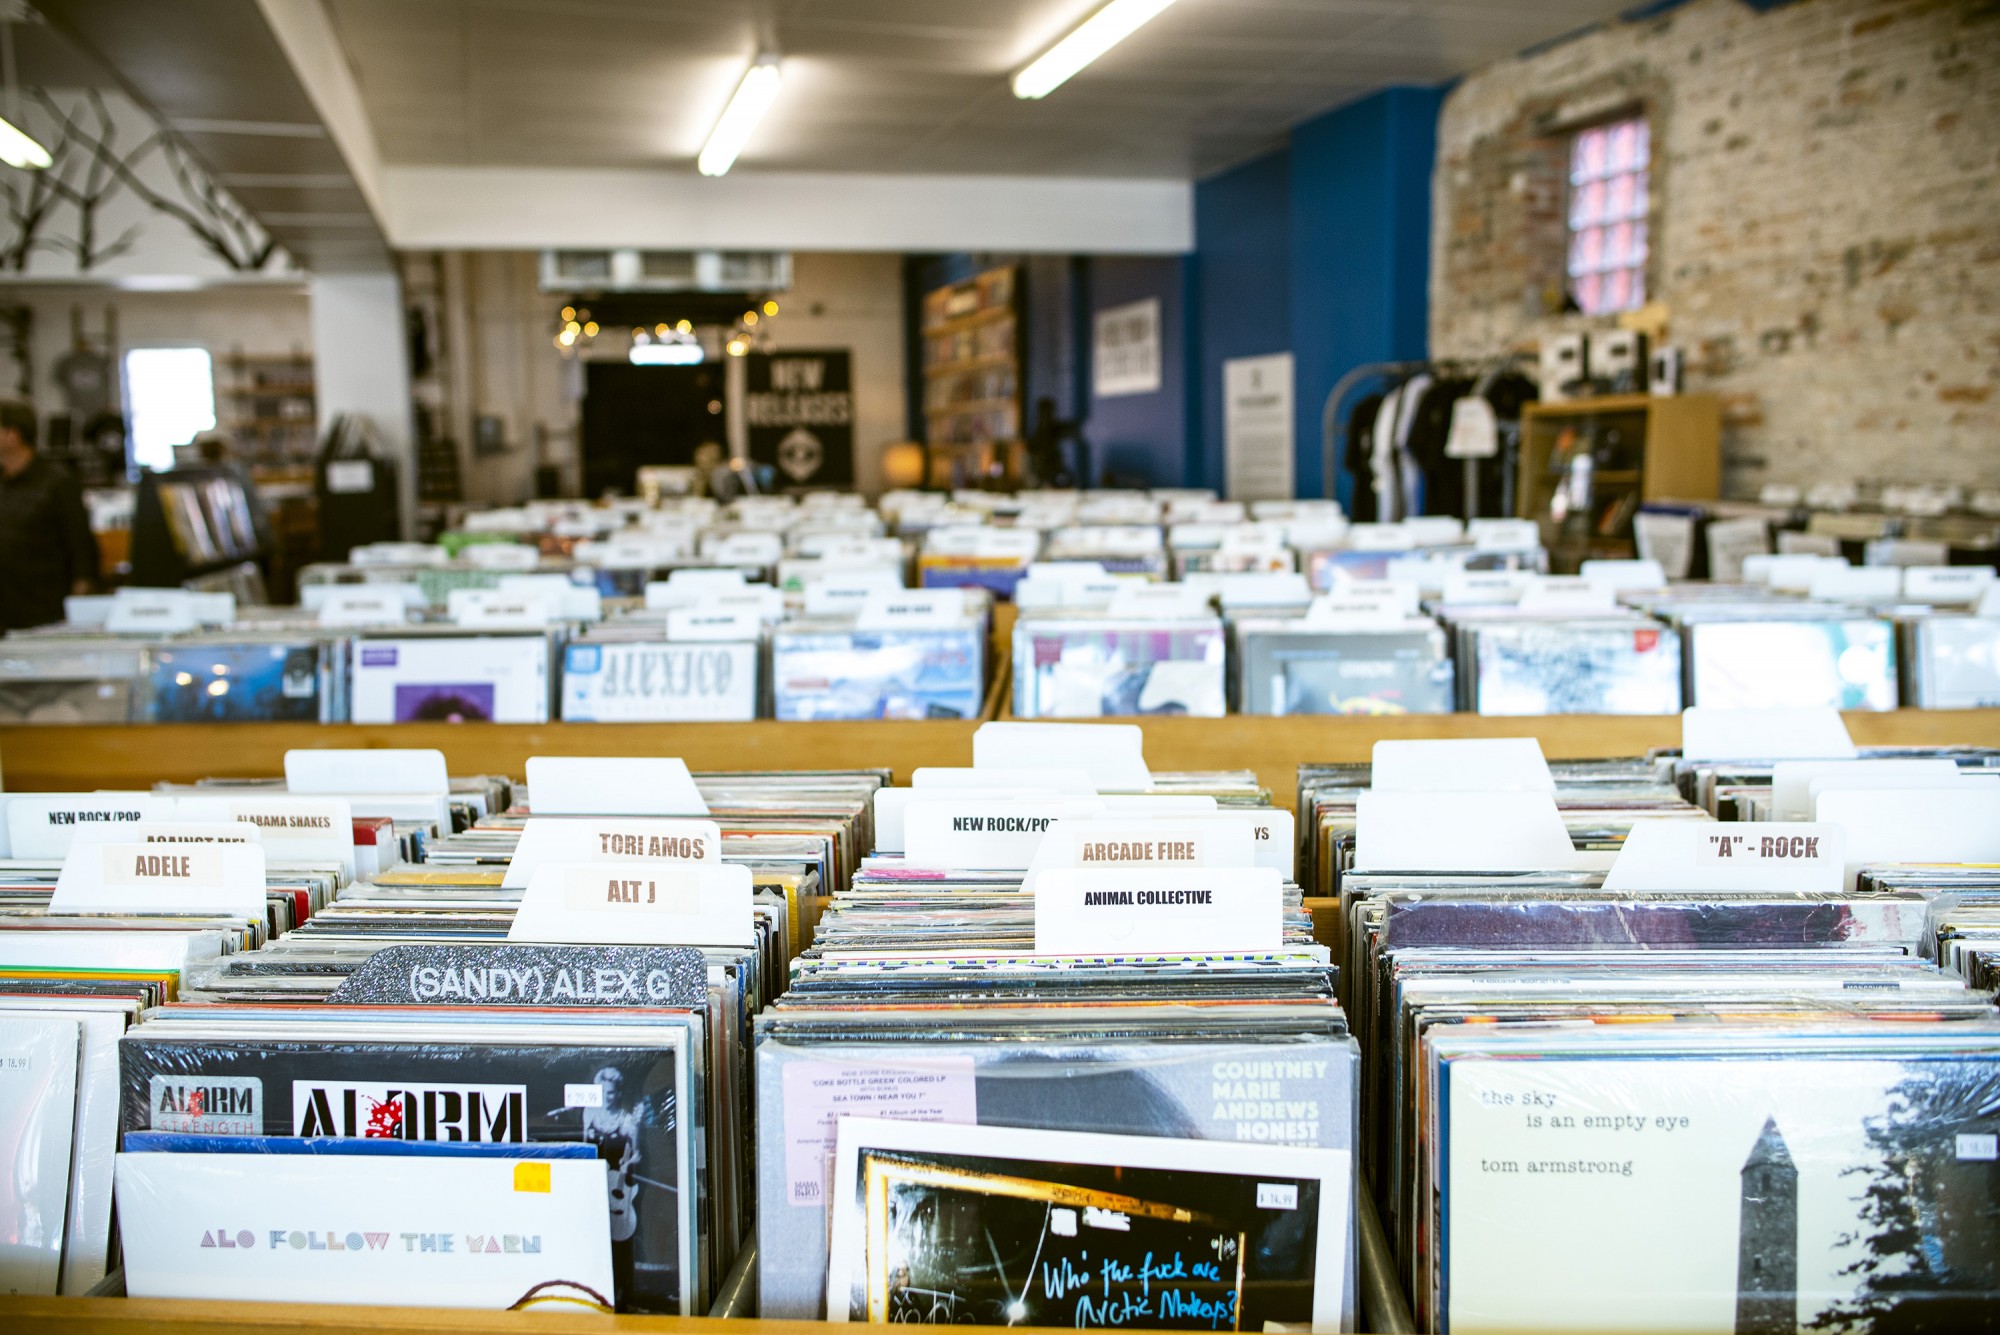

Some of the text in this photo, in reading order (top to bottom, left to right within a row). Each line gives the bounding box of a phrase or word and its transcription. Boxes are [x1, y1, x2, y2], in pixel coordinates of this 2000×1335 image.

[48, 811, 141, 825] NEW ROCK/POP
[237, 814, 331, 828] ALABAMA SHAKES
[953, 817, 1058, 832] NEW ROCK/PO
[599, 833, 705, 860] TORI AMOS
[1083, 842, 1195, 861] ARCADE FIRE
[1709, 836, 1743, 857] "A"
[1760, 836, 1820, 858] ROCK
[135, 855, 191, 878] ADELE
[607, 879, 656, 904] ALT J
[1084, 890, 1212, 906] ANIMAL COLLECTIVE
[410, 964, 671, 1004] (SANDY) ALEX G
[8, 1058, 27, 1069] 18.99
[1212, 1060, 1328, 1080] COURTNEY
[897, 1076, 935, 1084] COLORED
[1212, 1081, 1281, 1100] MARIE
[1481, 1090, 1557, 1108] the sky
[1212, 1100, 1320, 1120] ANDREWS
[160, 1120, 254, 1135] STRENGTH
[1236, 1121, 1319, 1141] HONEST
[1526, 1113, 1690, 1131] is an empty eye
[1481, 1158, 1633, 1176] tom armstrong
[200, 1229, 542, 1253] ALO FOLLOW THE YARN
[1100, 1258, 1134, 1298] the
[1137, 1251, 1188, 1298] fuck
[1075, 1290, 1153, 1329] Arctic
